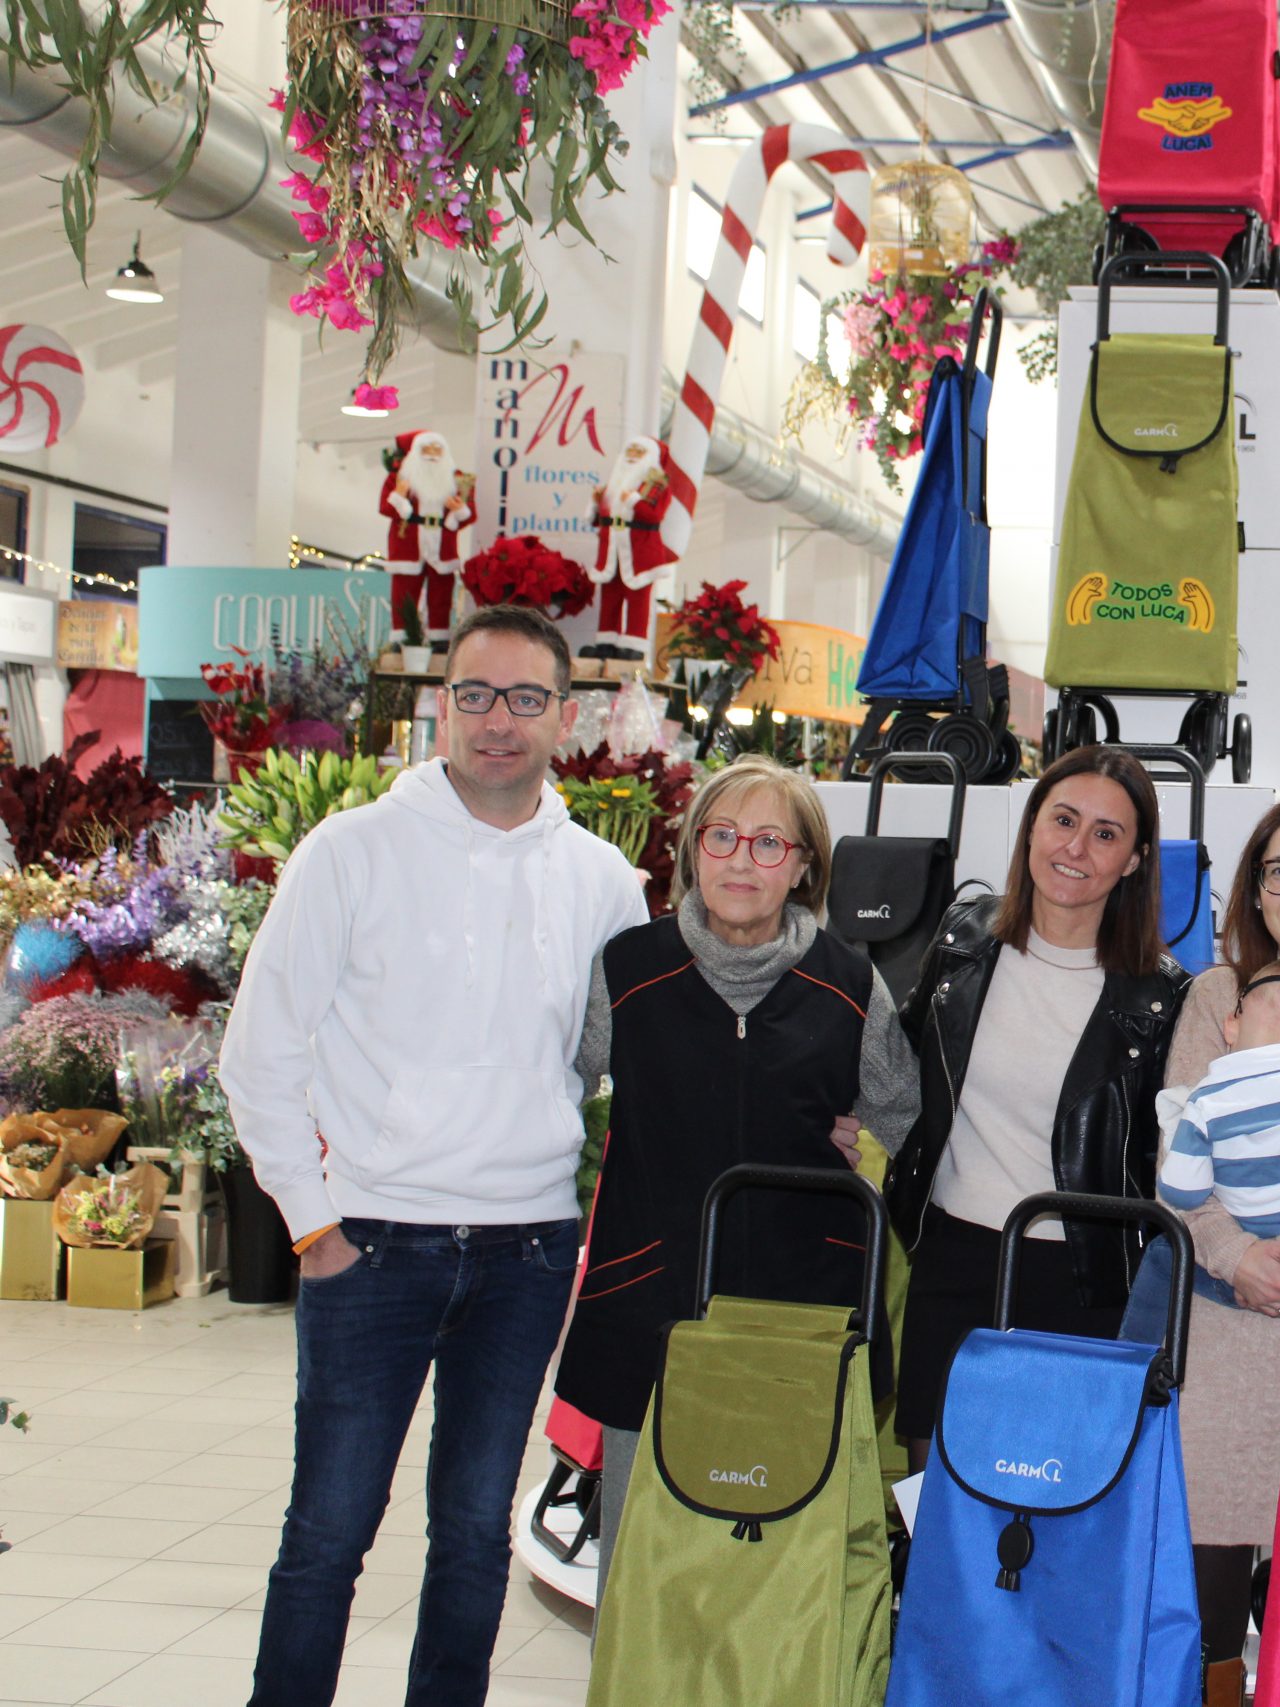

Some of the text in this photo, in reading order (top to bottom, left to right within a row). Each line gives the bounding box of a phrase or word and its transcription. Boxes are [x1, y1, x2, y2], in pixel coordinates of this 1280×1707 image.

[1163, 82, 1214, 99] ANEM
[1162, 135, 1213, 150] LUCA!
[1134, 423, 1178, 437] GARMOL
[524, 465, 600, 485] flores
[552, 491, 566, 509] y
[512, 513, 598, 534] planta
[1111, 582, 1173, 601] TODOS
[1096, 604, 1186, 623] CON LUCA
[857, 904, 891, 918] GARMOL
[709, 1465, 768, 1488] GARMOL
[995, 1458, 1063, 1484] GARMOL
